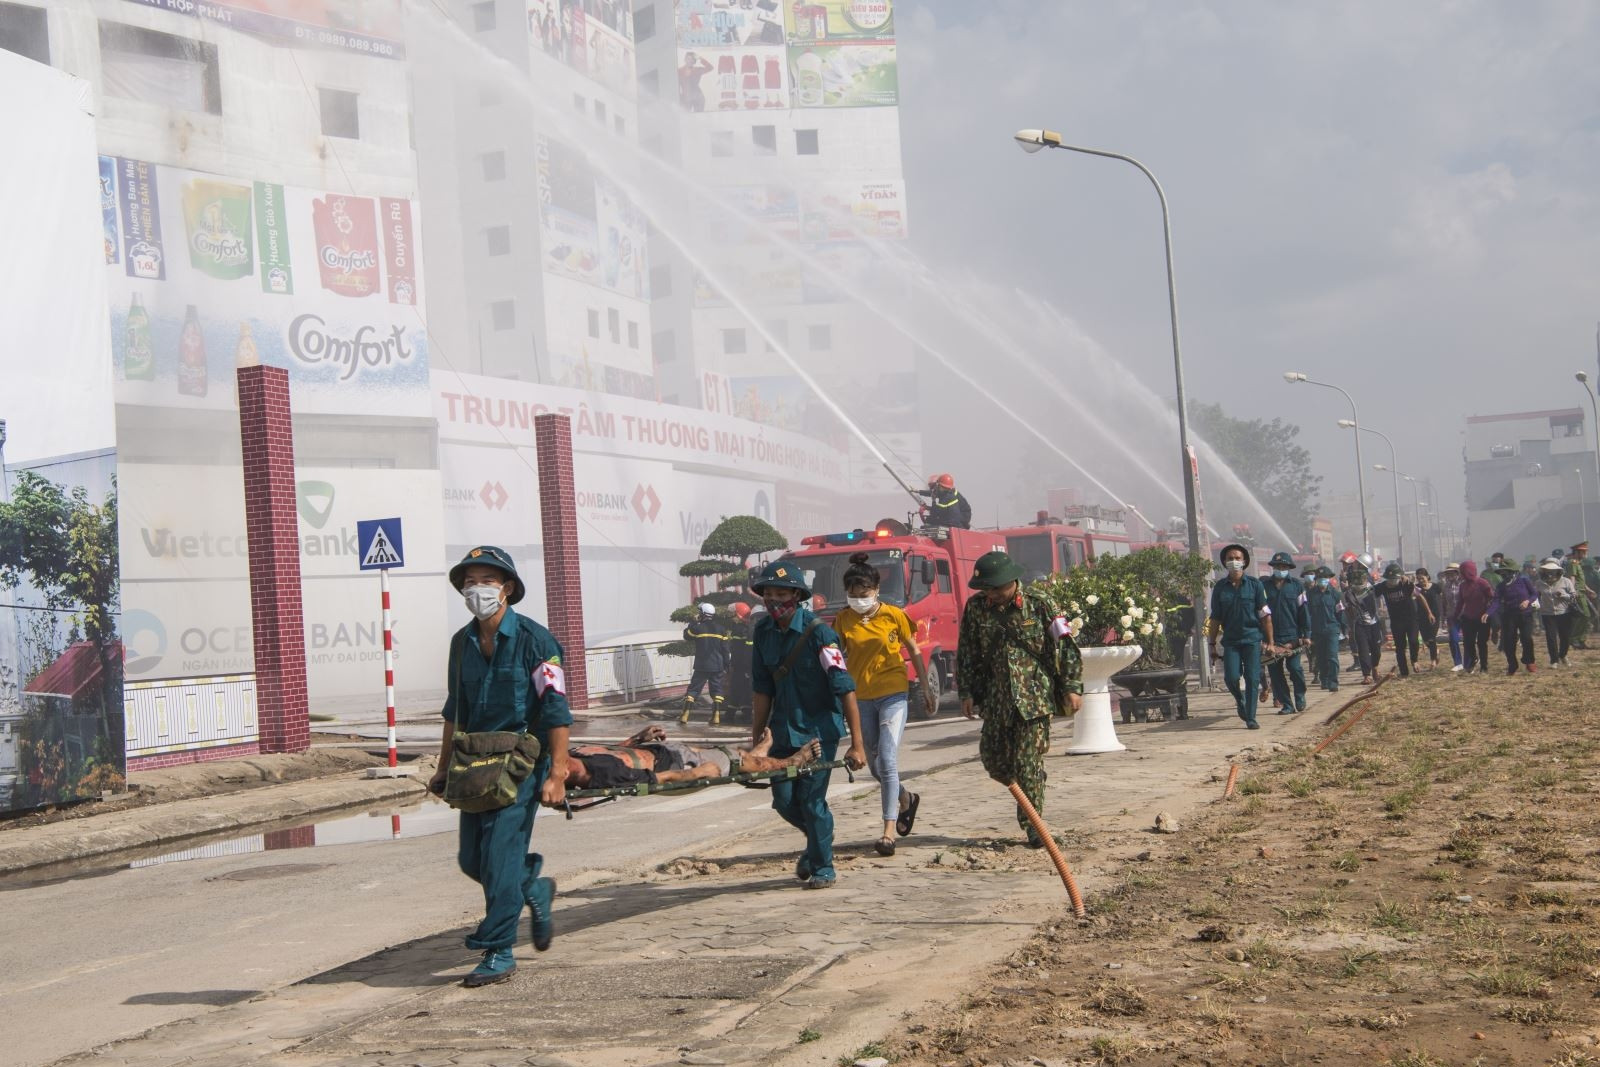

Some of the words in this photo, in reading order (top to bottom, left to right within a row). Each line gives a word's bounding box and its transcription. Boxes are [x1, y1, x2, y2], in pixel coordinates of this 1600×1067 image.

[199, 5, 233, 22] PHÁT
[318, 32, 393, 55] 0989.089.980
[128, 182, 137, 200] Ban
[265, 209, 275, 227] Gió
[194, 233, 245, 261] Comfort
[269, 229, 279, 262] Hương
[392, 224, 406, 267] Quyến
[321, 246, 375, 273] Comfort
[288, 313, 411, 380] Comfort
[622, 415, 709, 451] THƯƠNG
[714, 430, 745, 464] MẠI
[749, 426, 784, 465] TỔNG
[577, 491, 628, 511] OMBANK
[180, 627, 249, 655] OCE
